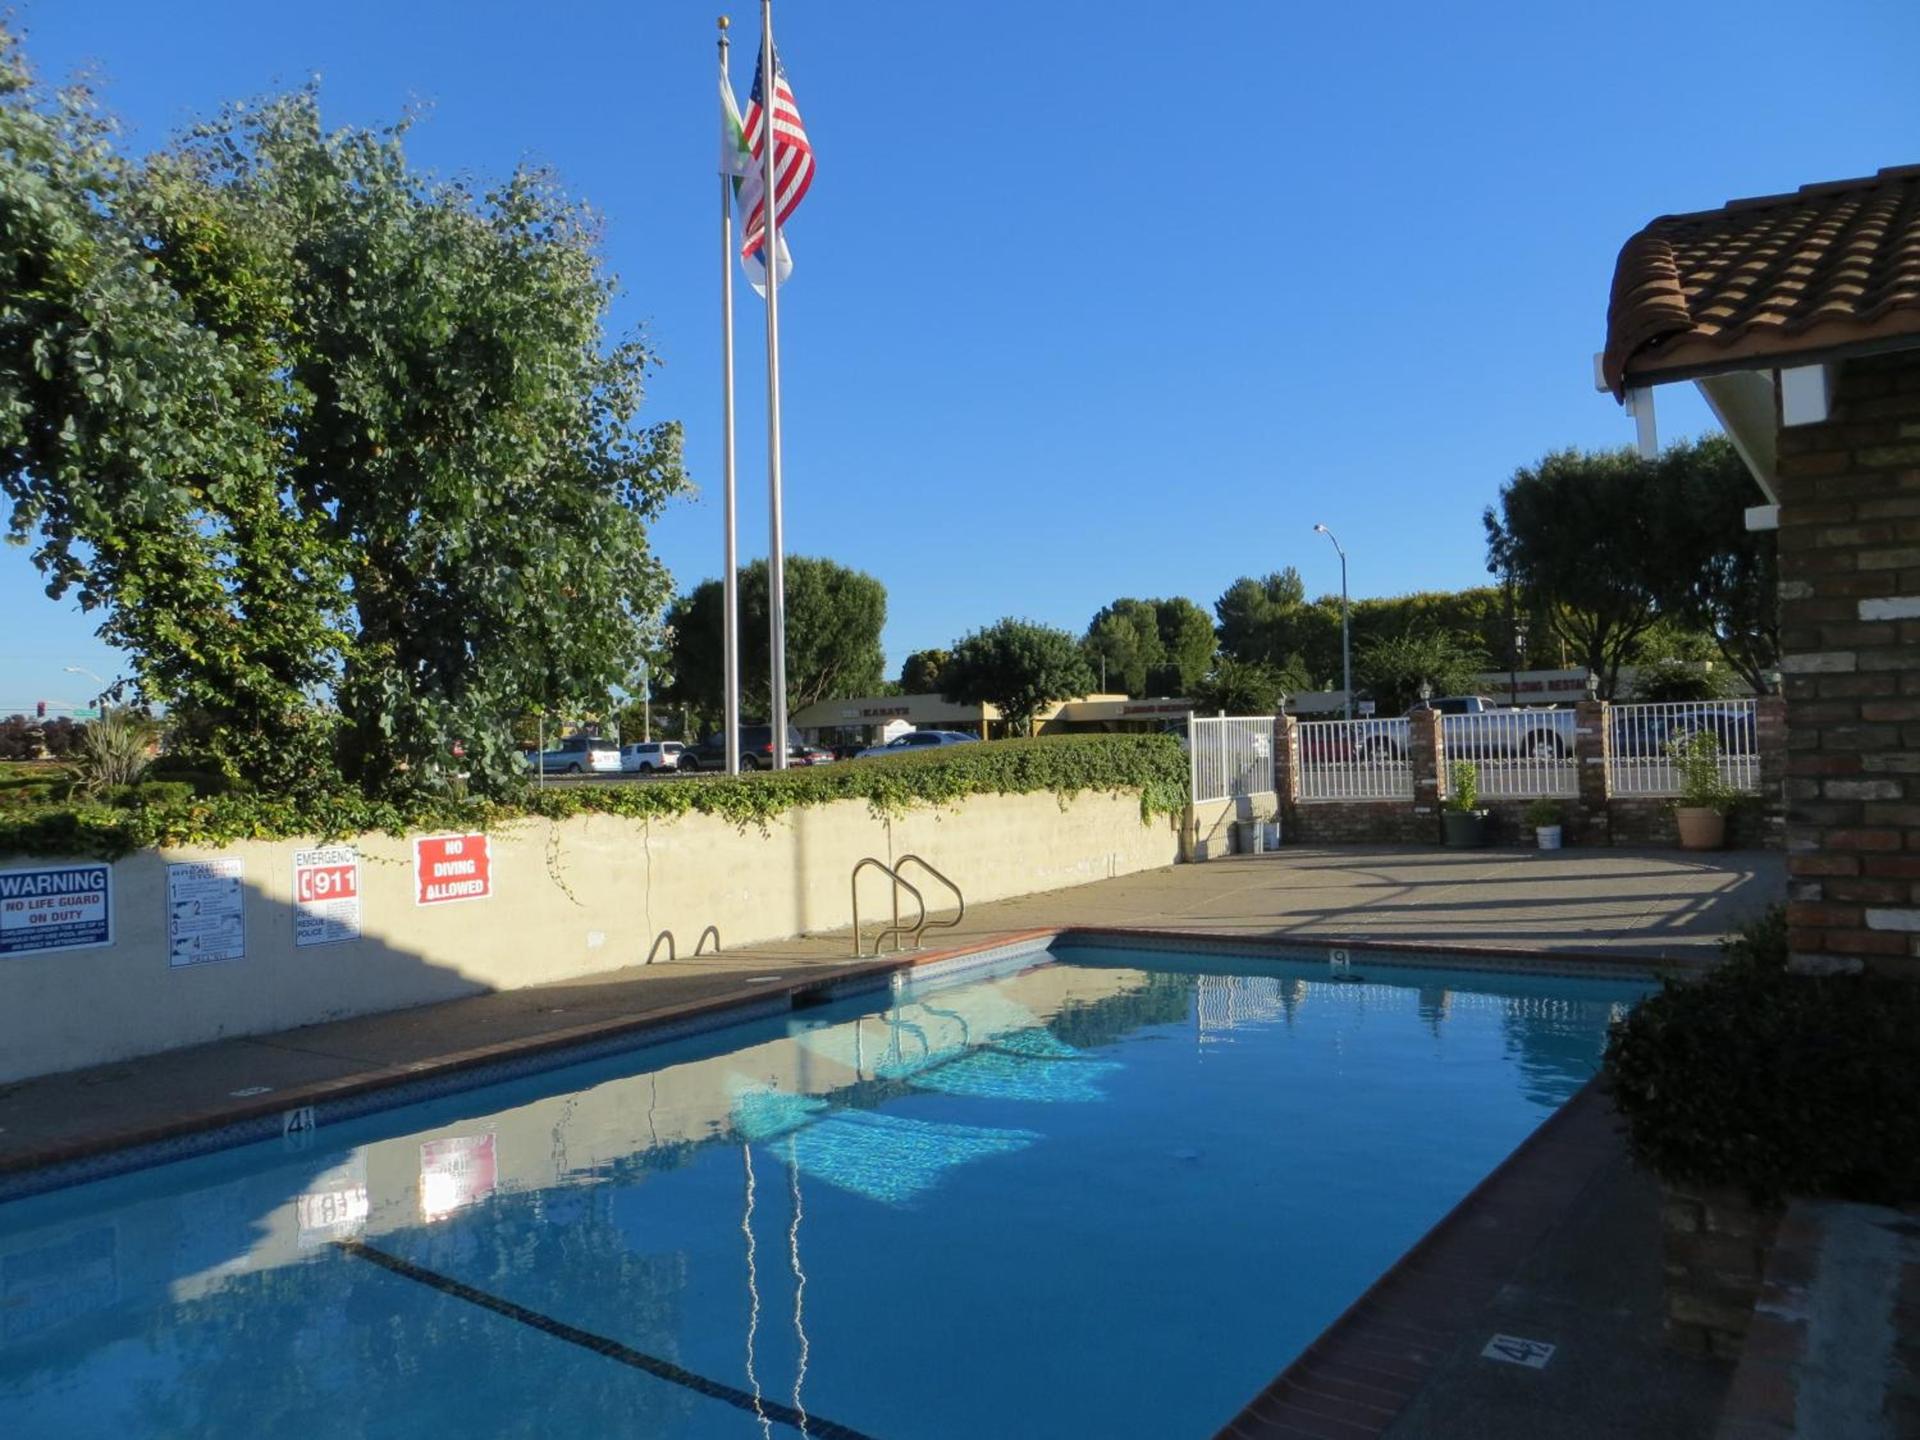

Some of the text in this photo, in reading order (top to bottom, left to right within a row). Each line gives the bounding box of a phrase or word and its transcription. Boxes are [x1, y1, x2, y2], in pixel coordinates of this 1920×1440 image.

[863, 707, 909, 718] KARATE
[445, 839, 463, 855] NO
[296, 849, 356, 866] EMERGENCY
[434, 859, 476, 877] DIVING
[0, 871, 105, 897] WARNING
[315, 869, 356, 894] 911
[426, 879, 484, 900] ALLOWED
[172, 883, 177, 898] 1
[6, 895, 100, 912] NO LIFE GUARD
[193, 900, 200, 916] 2
[29, 910, 82, 924] ON DUTY
[297, 918, 325, 927] RESCUE
[172, 920, 178, 935] 3
[297, 927, 322, 937] POLICE
[193, 935, 200, 949] 4
